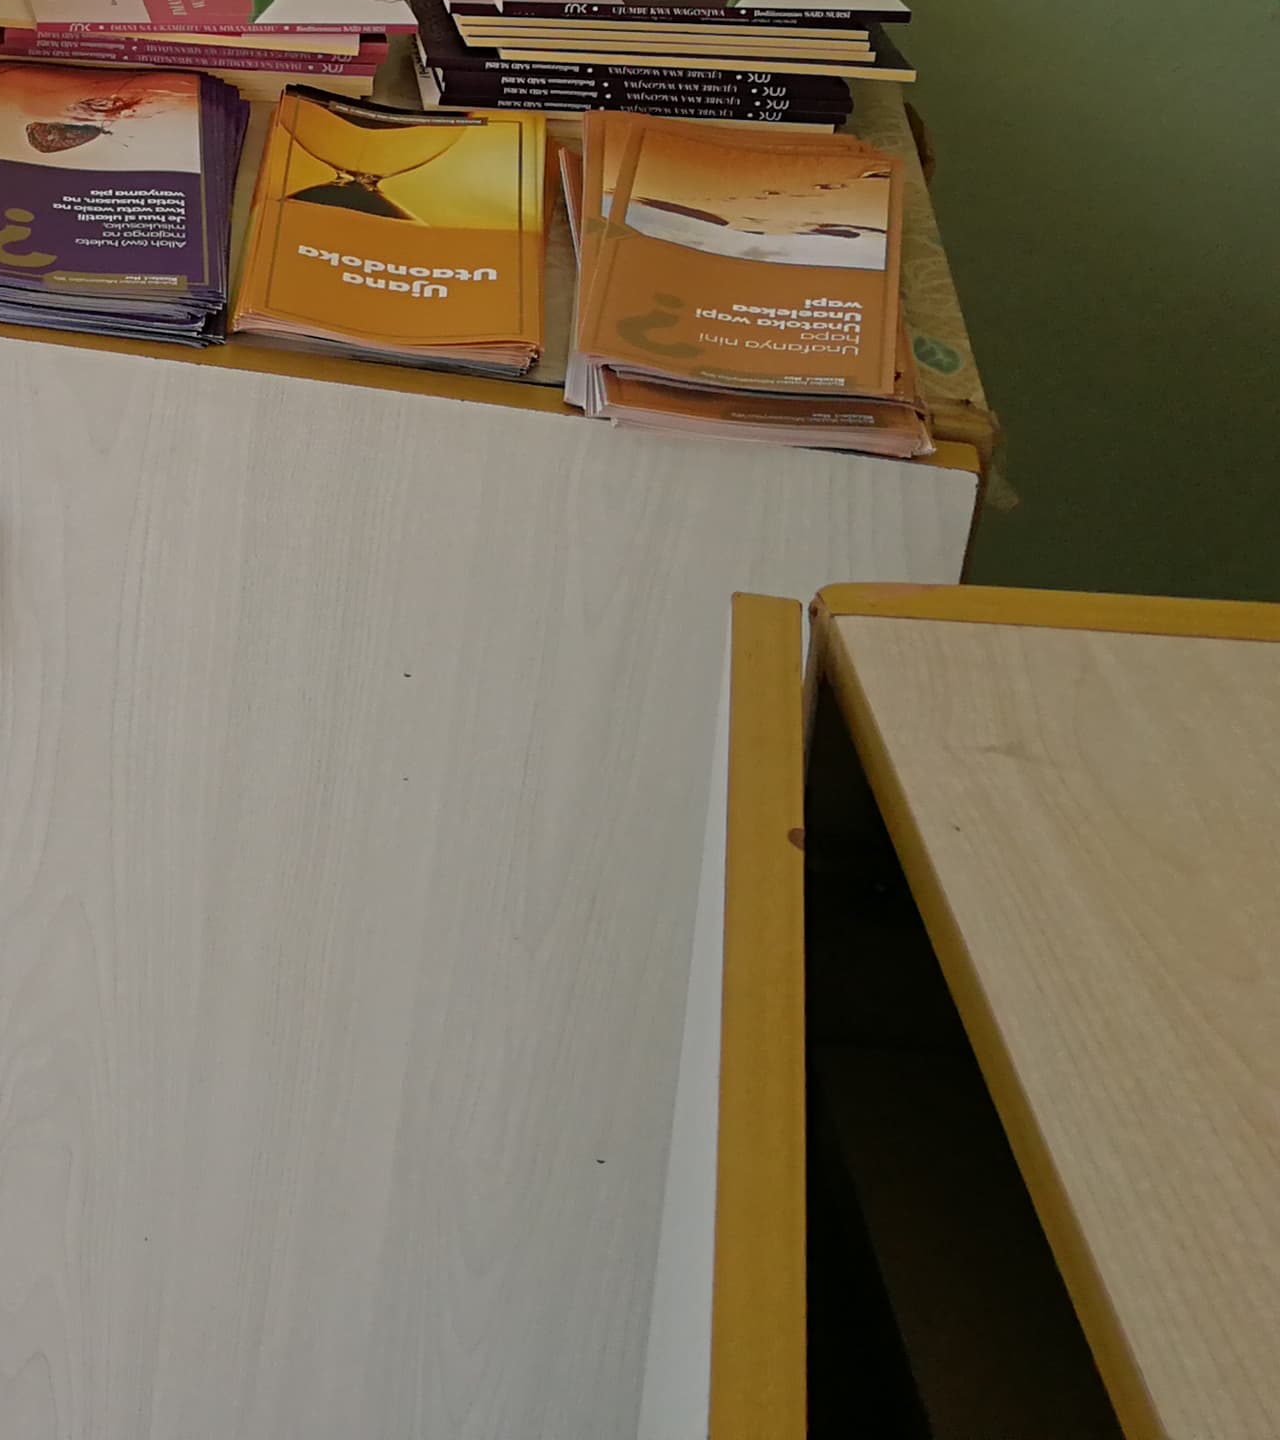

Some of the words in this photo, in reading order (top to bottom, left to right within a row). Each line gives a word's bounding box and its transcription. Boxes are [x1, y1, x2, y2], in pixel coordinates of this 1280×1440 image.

[608, 66, 660, 77] WAGONJWA
[662, 69, 684, 78] KWA
[686, 69, 722, 79] UJUMBE
[624, 80, 675, 91] WAGONJWA
[679, 82, 699, 92] KWA
[702, 83, 737, 93] UJUMBE
[626, 92, 678, 103] WAGONJWA
[681, 95, 702, 104] KWA
[704, 96, 740, 105] UJUMBE
[90, 189, 113, 197] pia
[115, 189, 186, 198] wanyama
[147, 199, 185, 207] hatia
[74, 205, 114, 213] wasio
[117, 206, 153, 214] watu
[155, 206, 185, 215] kwa
[78, 213, 122, 221] ukatili
[168, 215, 186, 223] Je
[123, 230, 186, 239] majanga
[75, 238, 119, 247] huleta
[151, 240, 187, 248] Allah
[298, 244, 498, 281] Utaondoka
[342, 272, 448, 299] Ujana
[804, 297, 863, 310] wapi
[695, 308, 751, 325] wapi
[732, 304, 862, 321] Unaelekea
[757, 319, 861, 333] Unatoka
[699, 332, 739, 347] nini
[800, 331, 860, 345] hapa
[745, 339, 859, 356] Unafanya
